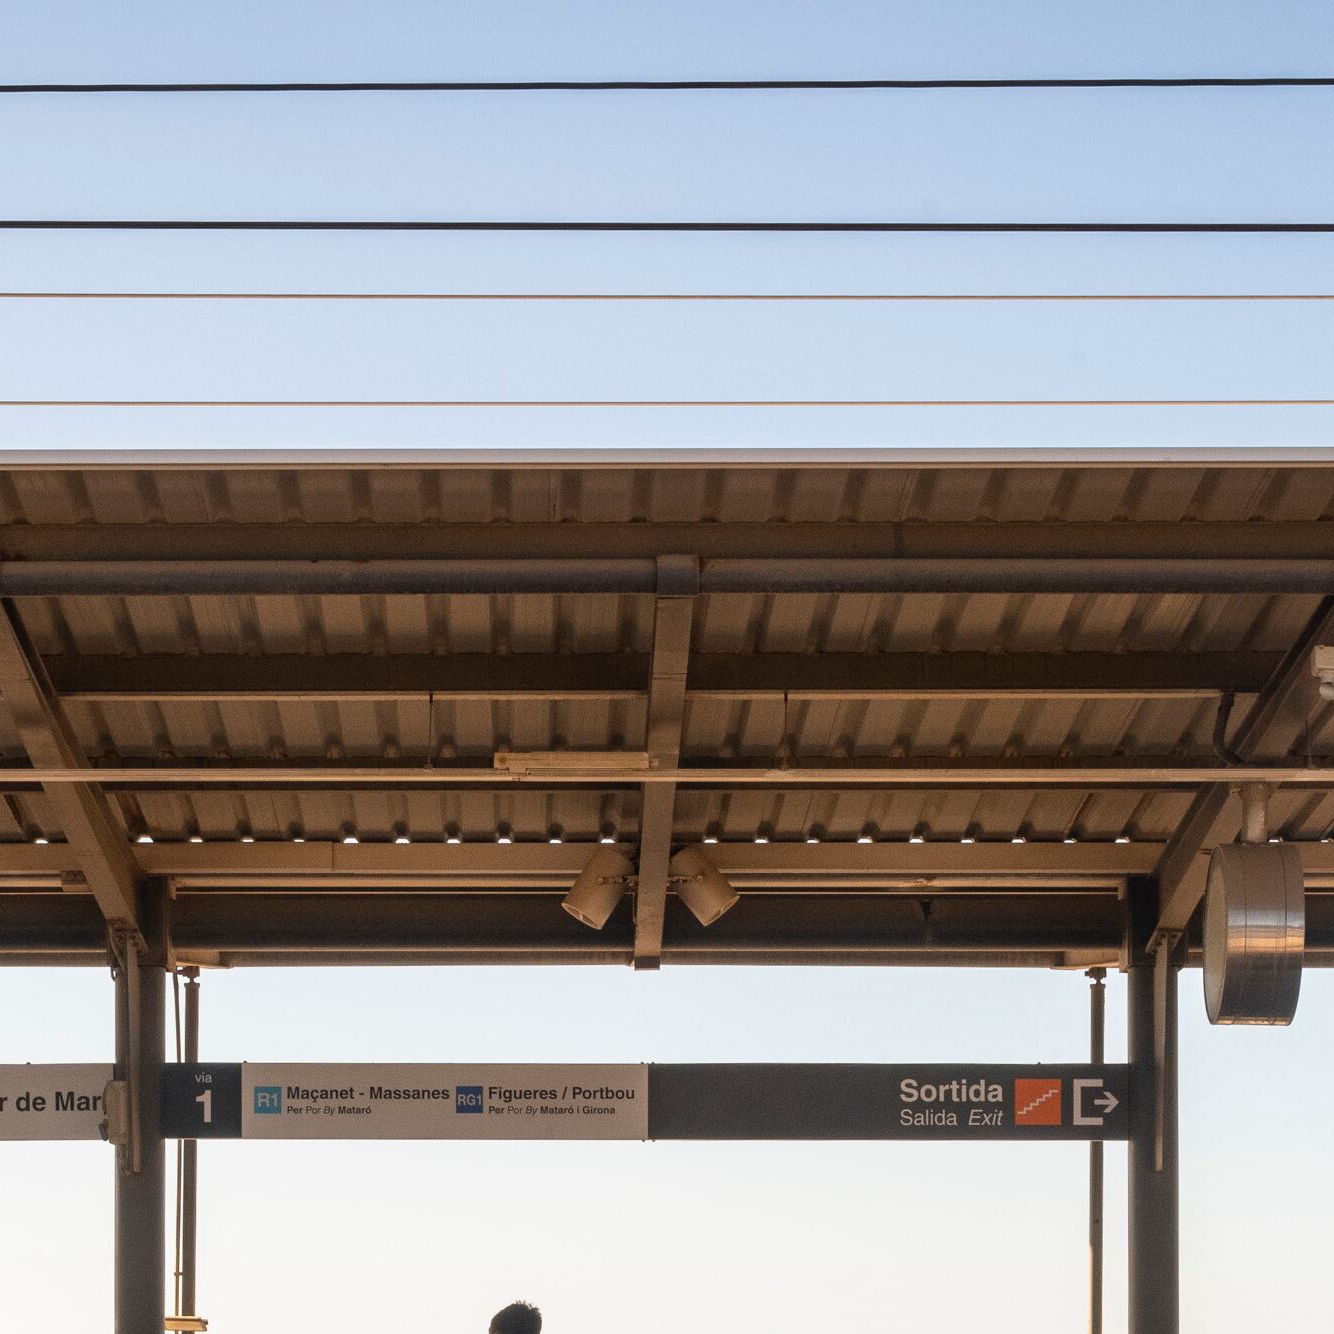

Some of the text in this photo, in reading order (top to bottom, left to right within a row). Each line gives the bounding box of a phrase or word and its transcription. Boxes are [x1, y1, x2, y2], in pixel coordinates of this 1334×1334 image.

[195, 1072, 213, 1084] via
[286, 1086, 355, 1103] Maçanet
[369, 1086, 450, 1100] Massanes
[488, 1086, 635, 1104] Figueres / Portbou
[899, 1078, 1003, 1103] Sortida
[15, 1091, 47, 1112] de
[55, 1091, 102, 1112] Mar
[195, 1089, 212, 1123] 1
[257, 1092, 279, 1108] R1
[457, 1093, 482, 1107] RG1
[286, 1105, 372, 1117] Per Por By Mataró
[488, 1105, 616, 1117] Per Por By Mataró i Girona
[900, 1108, 1004, 1126] Salida Exit
